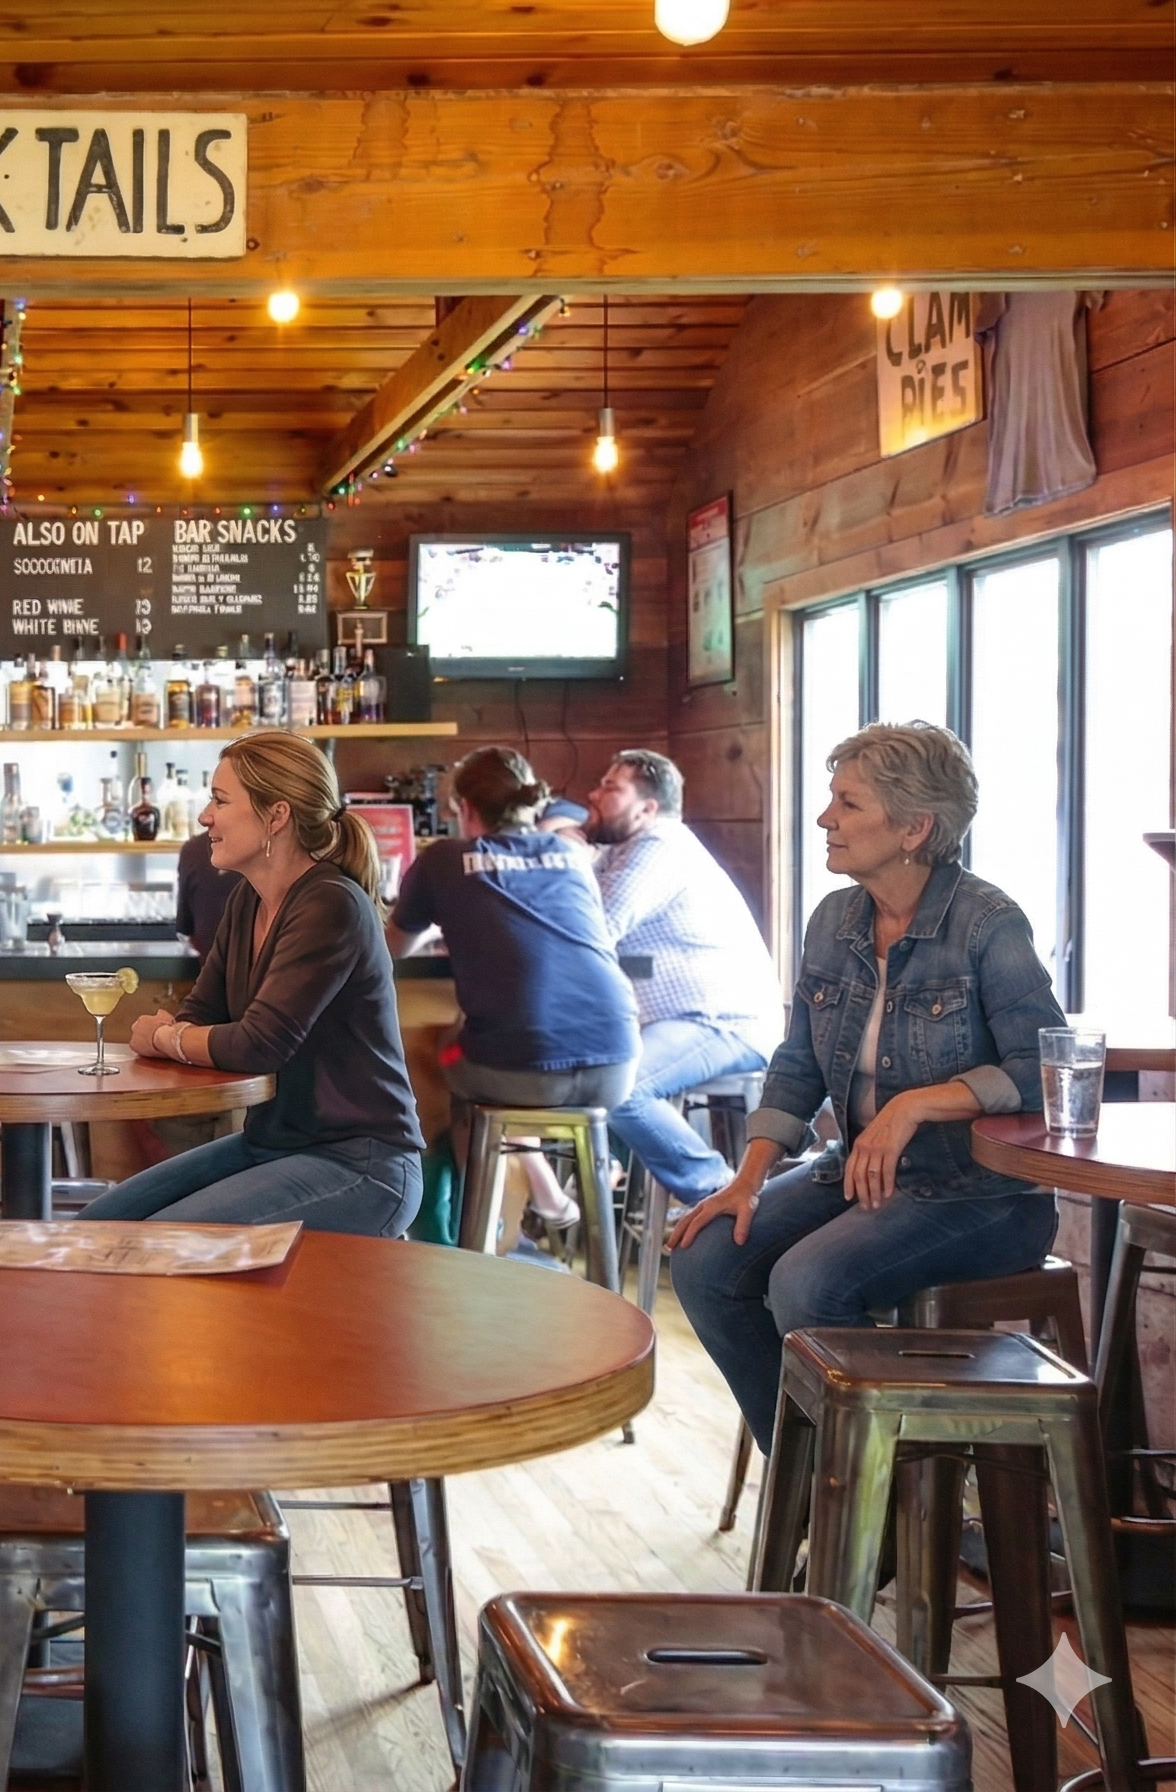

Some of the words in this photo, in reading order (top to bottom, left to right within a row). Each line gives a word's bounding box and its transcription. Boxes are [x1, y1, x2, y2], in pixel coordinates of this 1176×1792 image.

[901, 359, 970, 431] PIES
[13, 522, 65, 546] ALSO
[72, 521, 99, 545] ON
[107, 520, 145, 545] TAP
[174, 519, 212, 543] BAR
[217, 519, 297, 544] SNACKS
[12, 599, 42, 615] RED
[12, 618, 57, 635] WHITE
